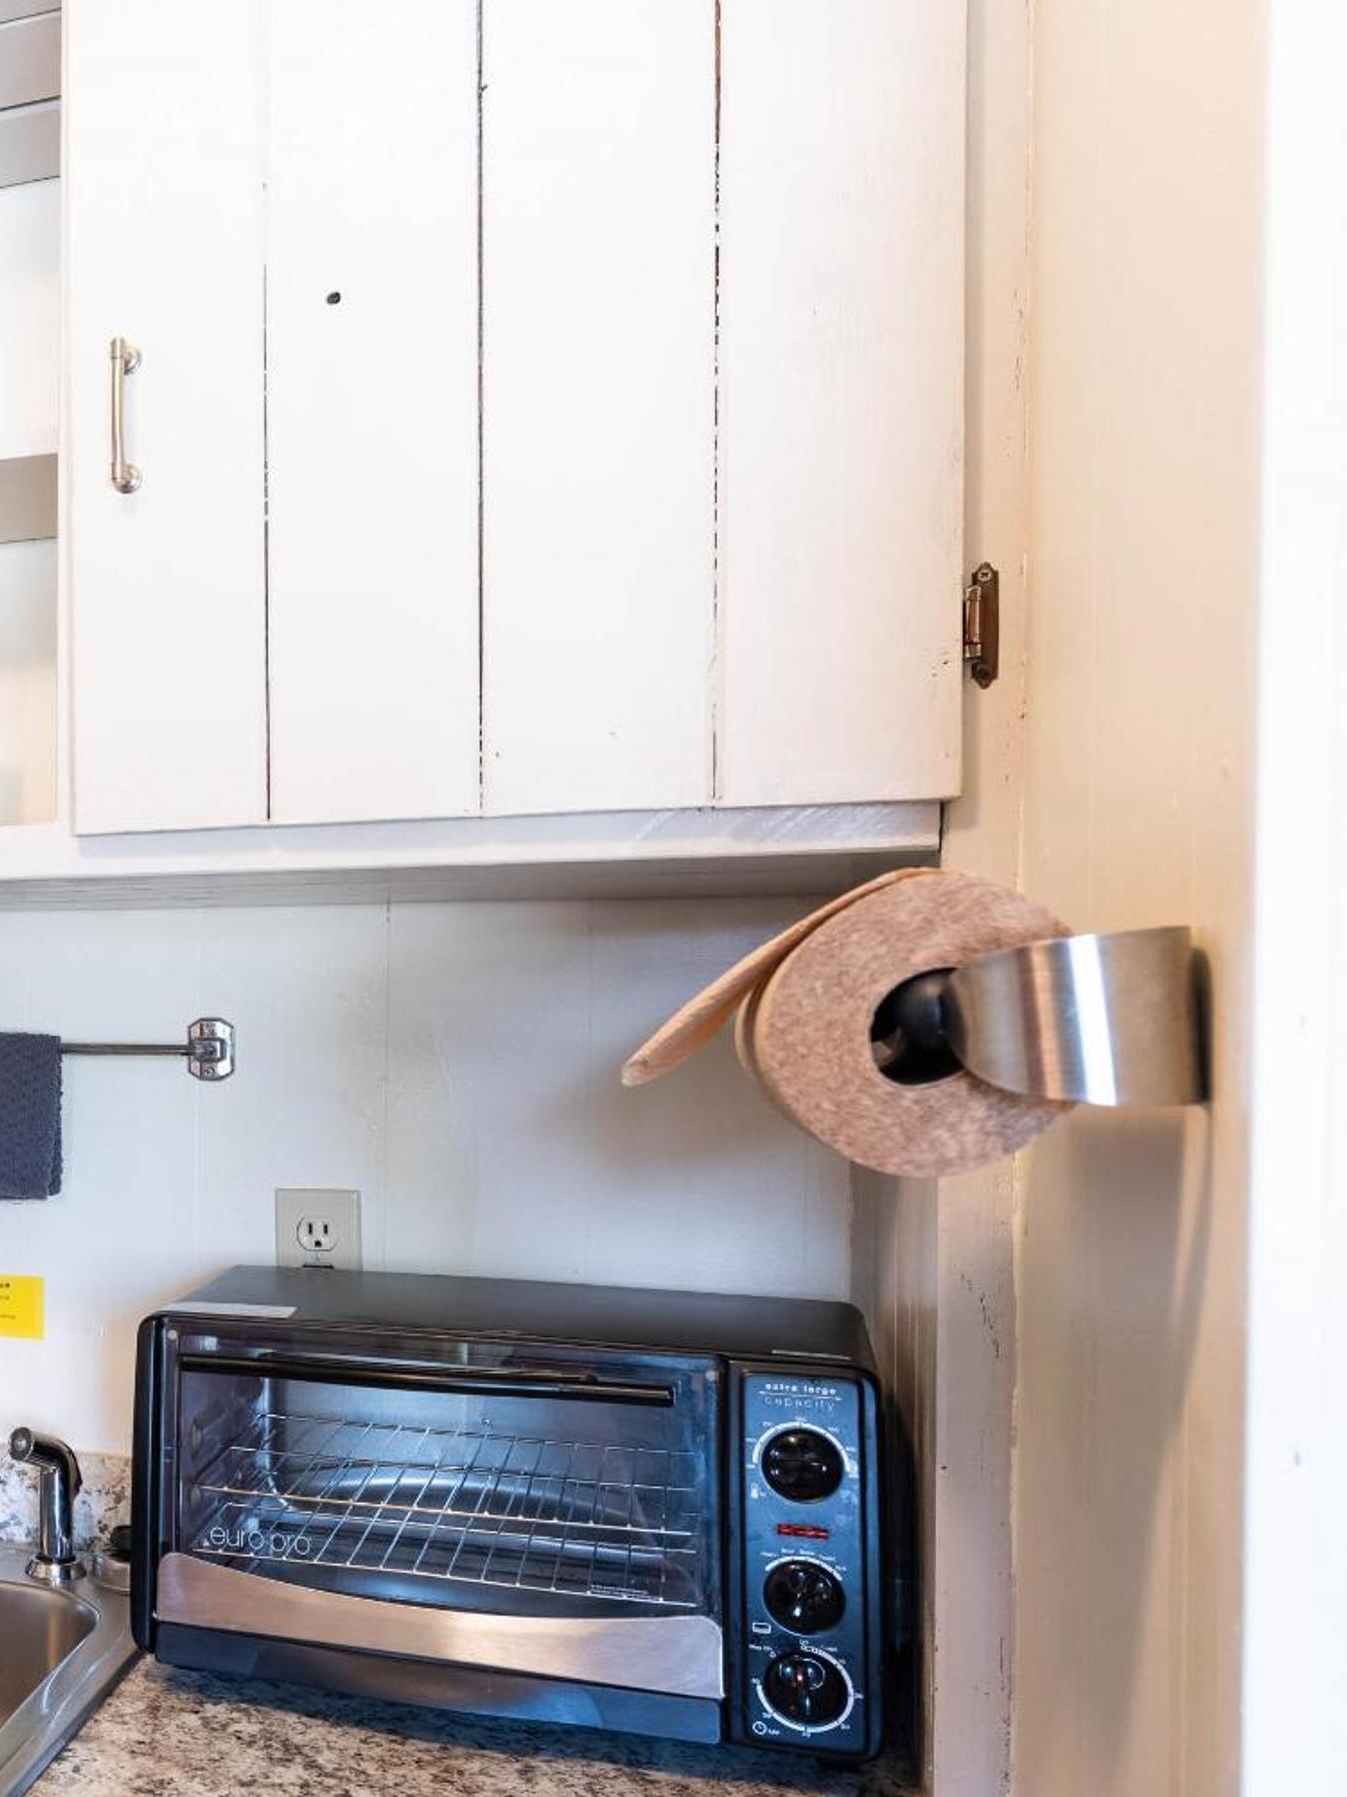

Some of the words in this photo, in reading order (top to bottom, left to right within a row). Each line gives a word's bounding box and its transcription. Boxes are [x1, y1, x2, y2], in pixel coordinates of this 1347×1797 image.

[765, 1383, 798, 1392] extra
[803, 1385, 837, 1396] large
[210, 1527, 265, 1550] euro
[270, 1532, 311, 1557] pro
